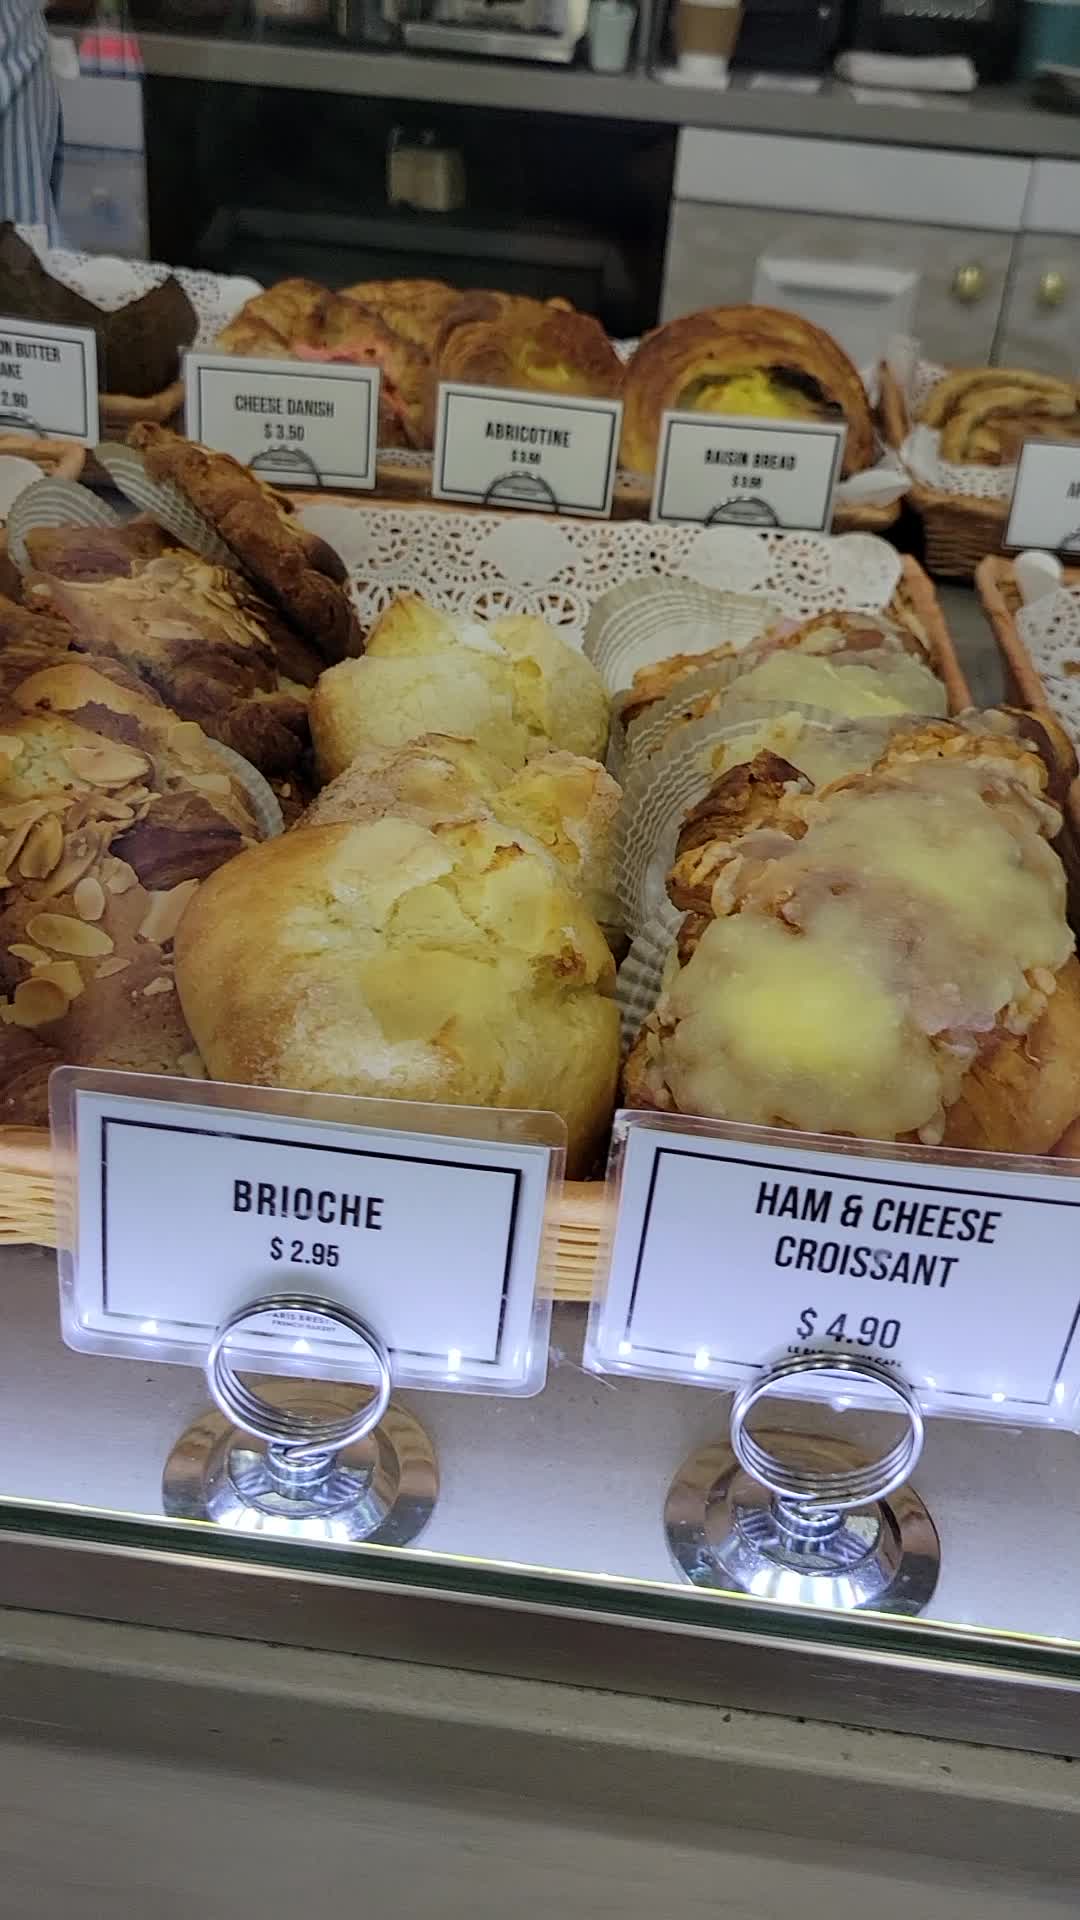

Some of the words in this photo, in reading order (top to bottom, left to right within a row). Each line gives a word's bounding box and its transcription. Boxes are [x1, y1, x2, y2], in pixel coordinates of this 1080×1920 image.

[16, 343, 61, 362] BUTTER
[0, 363, 23, 380] AKE
[234, 395, 284, 414] CHEESE
[287, 399, 335, 417] DANISH
[264, 422, 272, 440] $
[277, 424, 305, 441] 3.50
[486, 421, 572, 448] ABRICOTINE
[704, 449, 748, 466] RAISIN
[753, 453, 796, 471] BREAD
[233, 1179, 385, 1231] BRIOCHE
[755, 1181, 833, 1223] HAM
[839, 1194, 863, 1228] &
[872, 1198, 1003, 1244] CHEESE
[270, 1236, 283, 1261] $
[290, 1239, 340, 1267] 2.95
[775, 1235, 960, 1289] CROISSANT
[796, 1306, 818, 1341] $
[825, 1312, 901, 1349] 4.90
